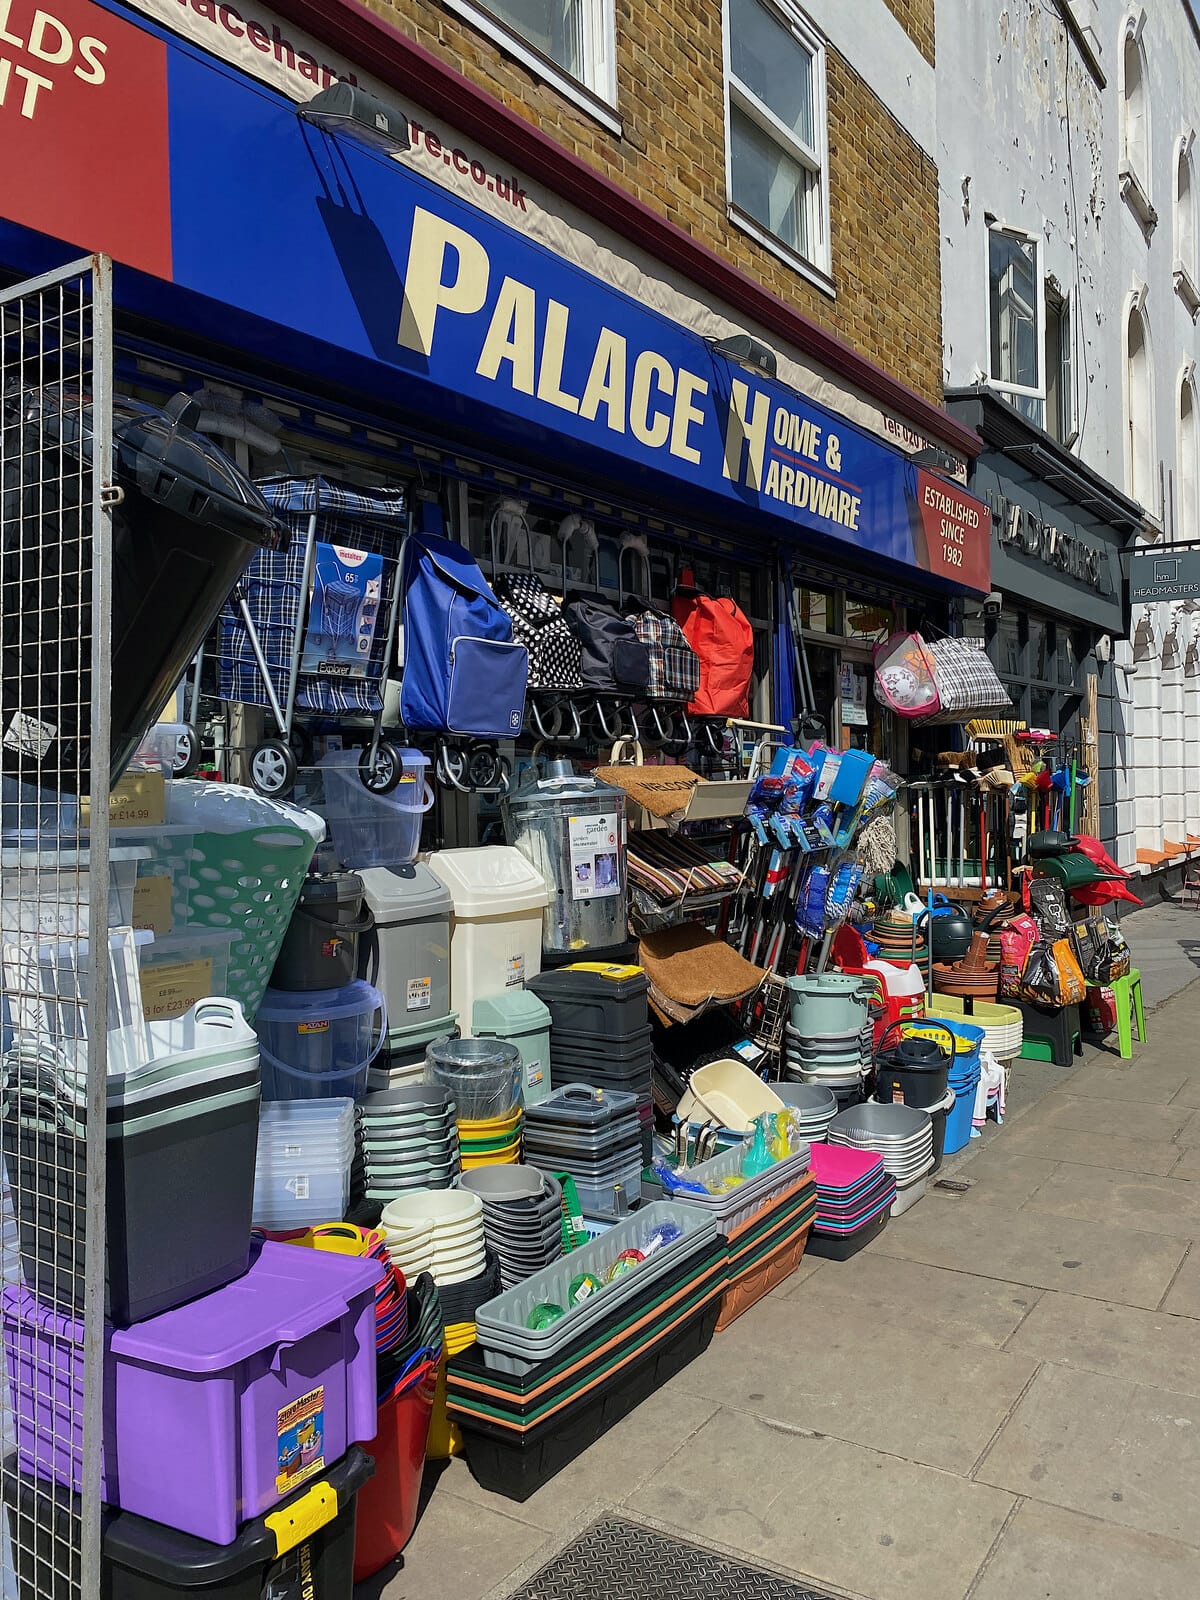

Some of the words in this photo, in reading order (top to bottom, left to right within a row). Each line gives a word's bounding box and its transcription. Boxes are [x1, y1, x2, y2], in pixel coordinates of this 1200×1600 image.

[397, 204, 709, 466] PALACE
[825, 433, 843, 473] &
[884, 415, 901, 438] Tel:
[924, 485, 980, 530] ESTABLISHED
[983, 505, 990, 517] 57
[940, 518, 965, 546] SINCE
[942, 543, 963, 568] 1982
[344, 572, 354, 583] 65
[1133, 583, 1199, 598] HEADMASTERS
[319, 661, 350, 676] Explorer
[635, 778, 698, 792] WELCOM
[119, 809, 149, 820] £14.99
[145, 1006, 151, 1016] 3
[153, 1004, 165, 1014] for
[167, 997, 195, 1012] £23.99
[300, 1543, 313, 1585] HEAVY
